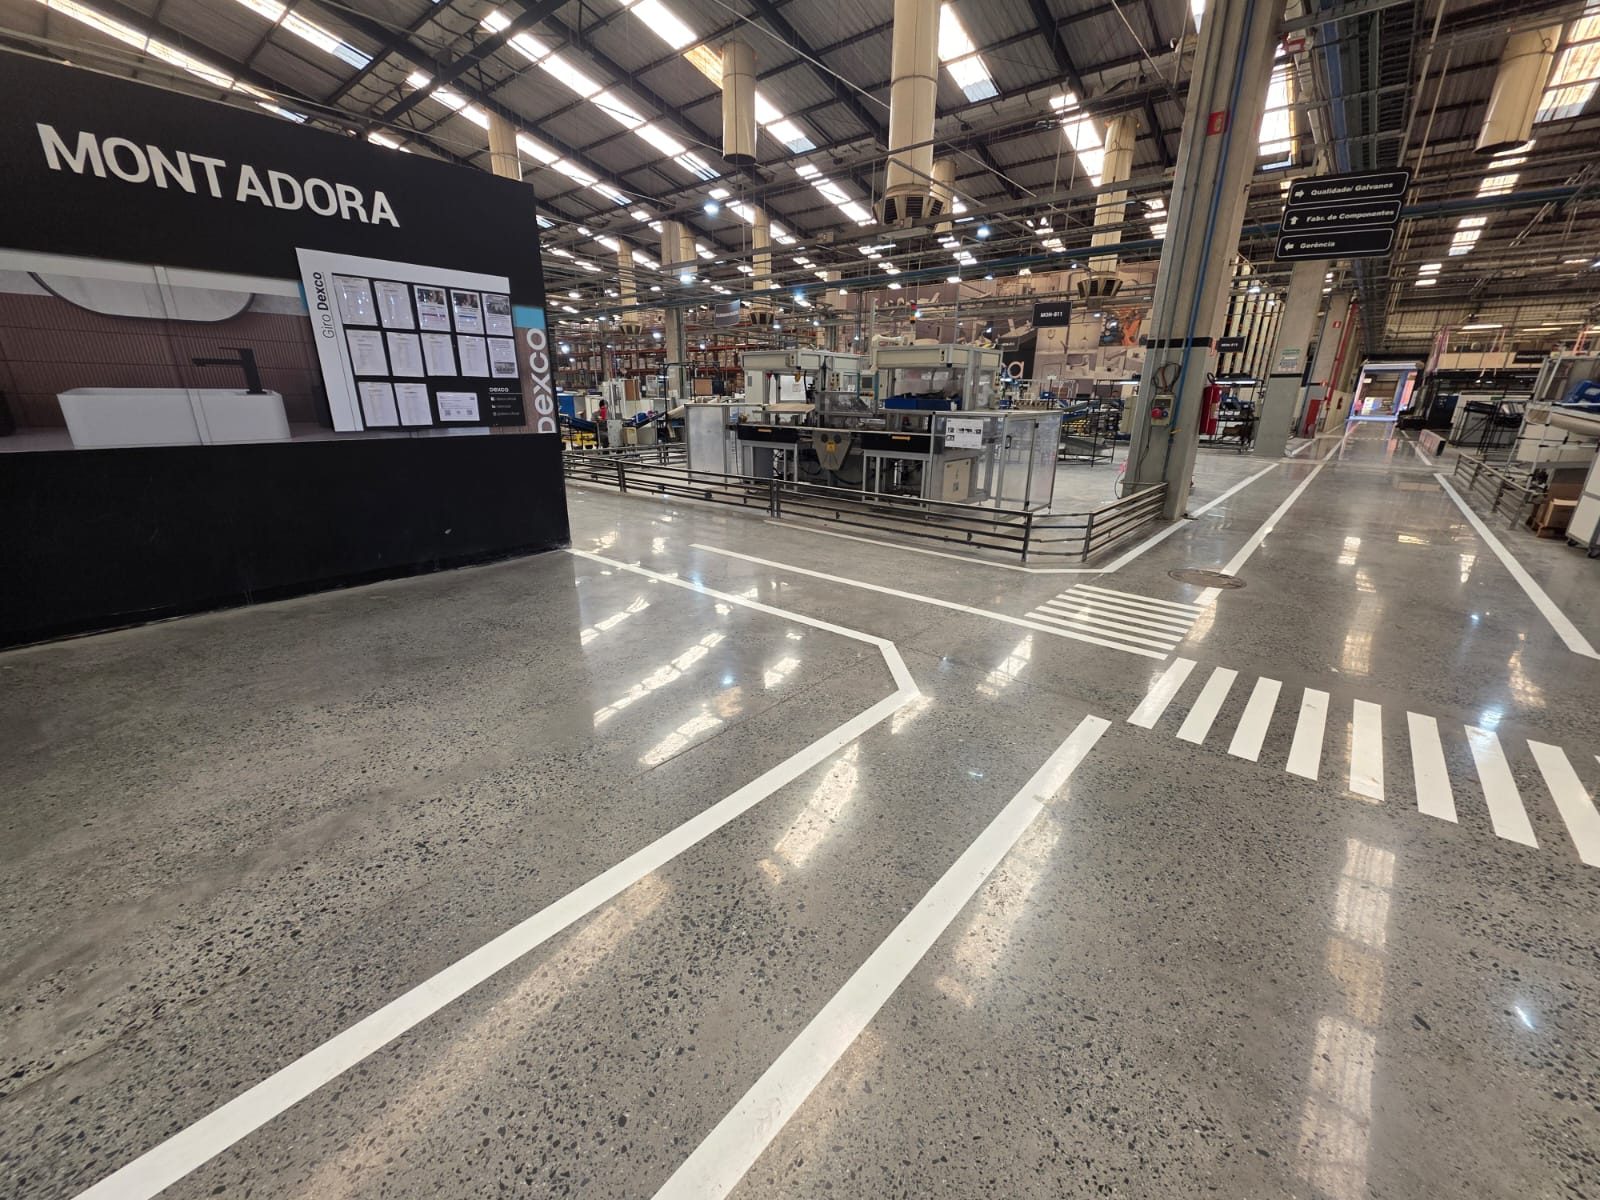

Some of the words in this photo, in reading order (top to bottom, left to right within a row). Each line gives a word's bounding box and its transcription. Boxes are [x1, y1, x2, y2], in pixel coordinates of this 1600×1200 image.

[36, 123, 400, 227] MONTADORA
[1339, 209, 1395, 220] Componentes
[1300, 241, 1335, 249] Gerência
[313, 271, 329, 311] Dexco
[321, 314, 334, 338] Giro
